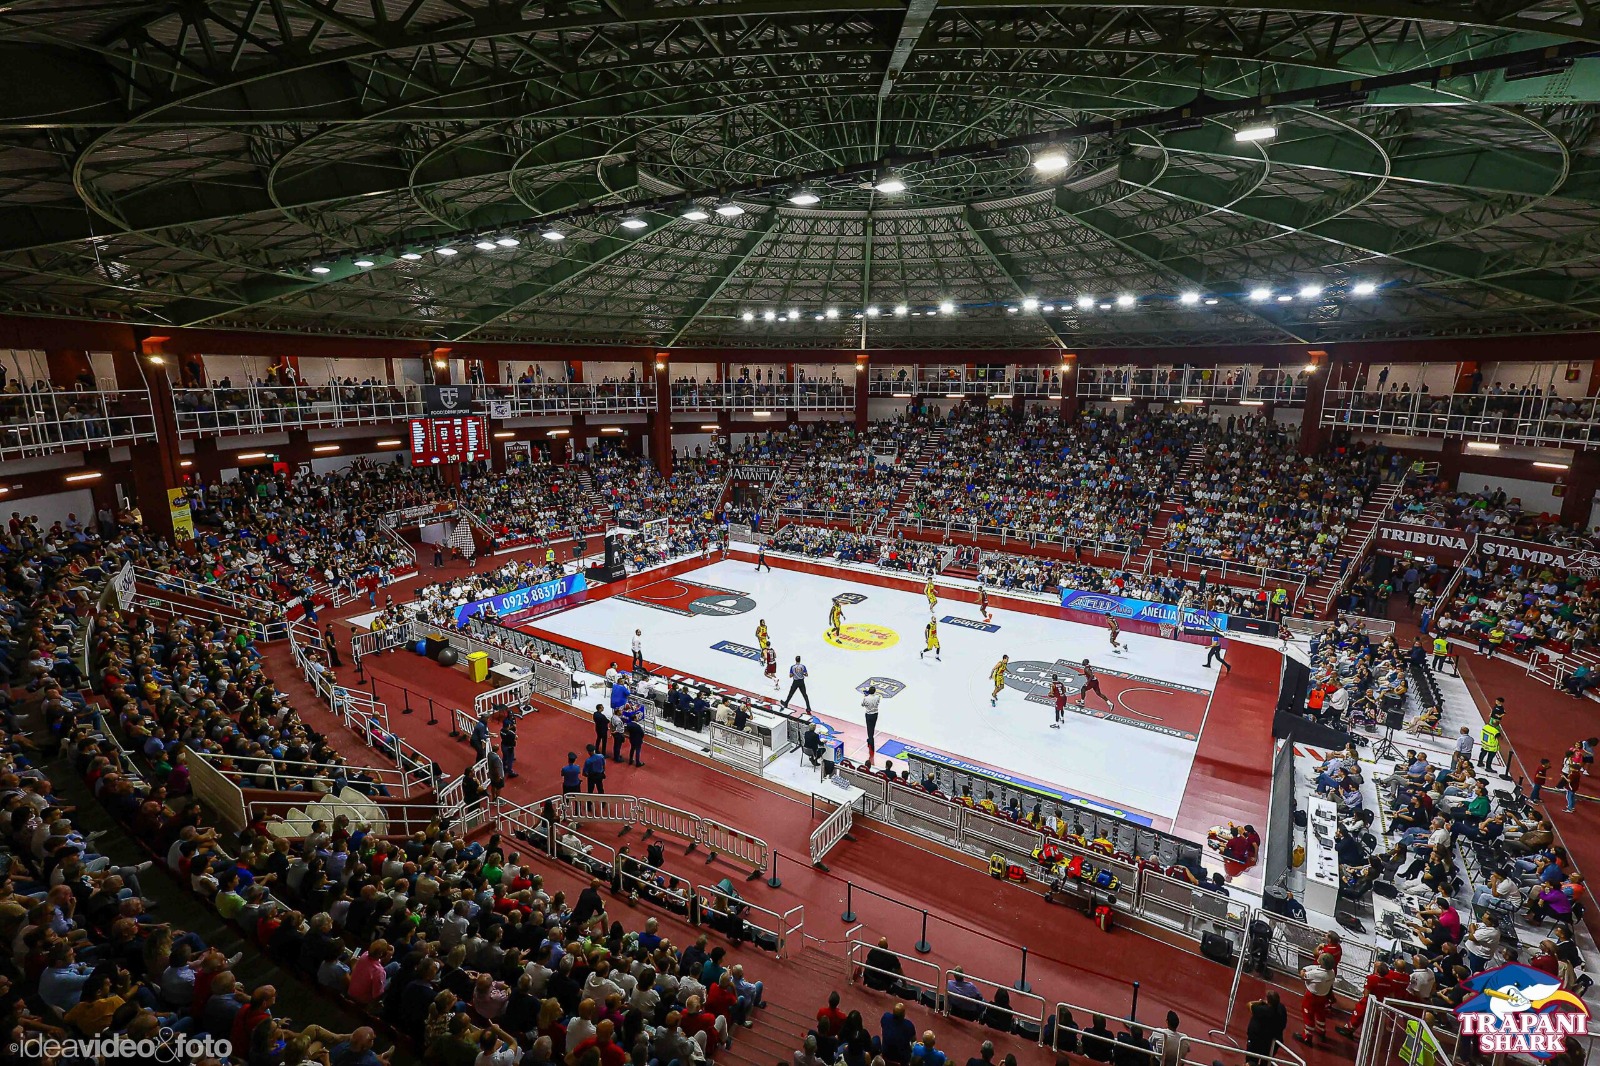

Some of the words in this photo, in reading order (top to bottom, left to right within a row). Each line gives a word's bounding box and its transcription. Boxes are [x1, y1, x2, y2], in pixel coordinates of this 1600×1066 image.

[733, 470, 776, 480] AMANTIA
[1379, 527, 1468, 551] TRIBUNA
[1481, 542, 1567, 568] STAMPA
[502, 594, 529, 610] 0923
[531, 581, 567, 602] 883727
[949, 618, 992, 631] Unipol
[720, 643, 759, 660] Unipol
[1109, 716, 1182, 736] fotodiscount
[904, 745, 948, 762] noleggio
[951, 759, 960, 767] di
[961, 763, 1012, 780] soluzioni
